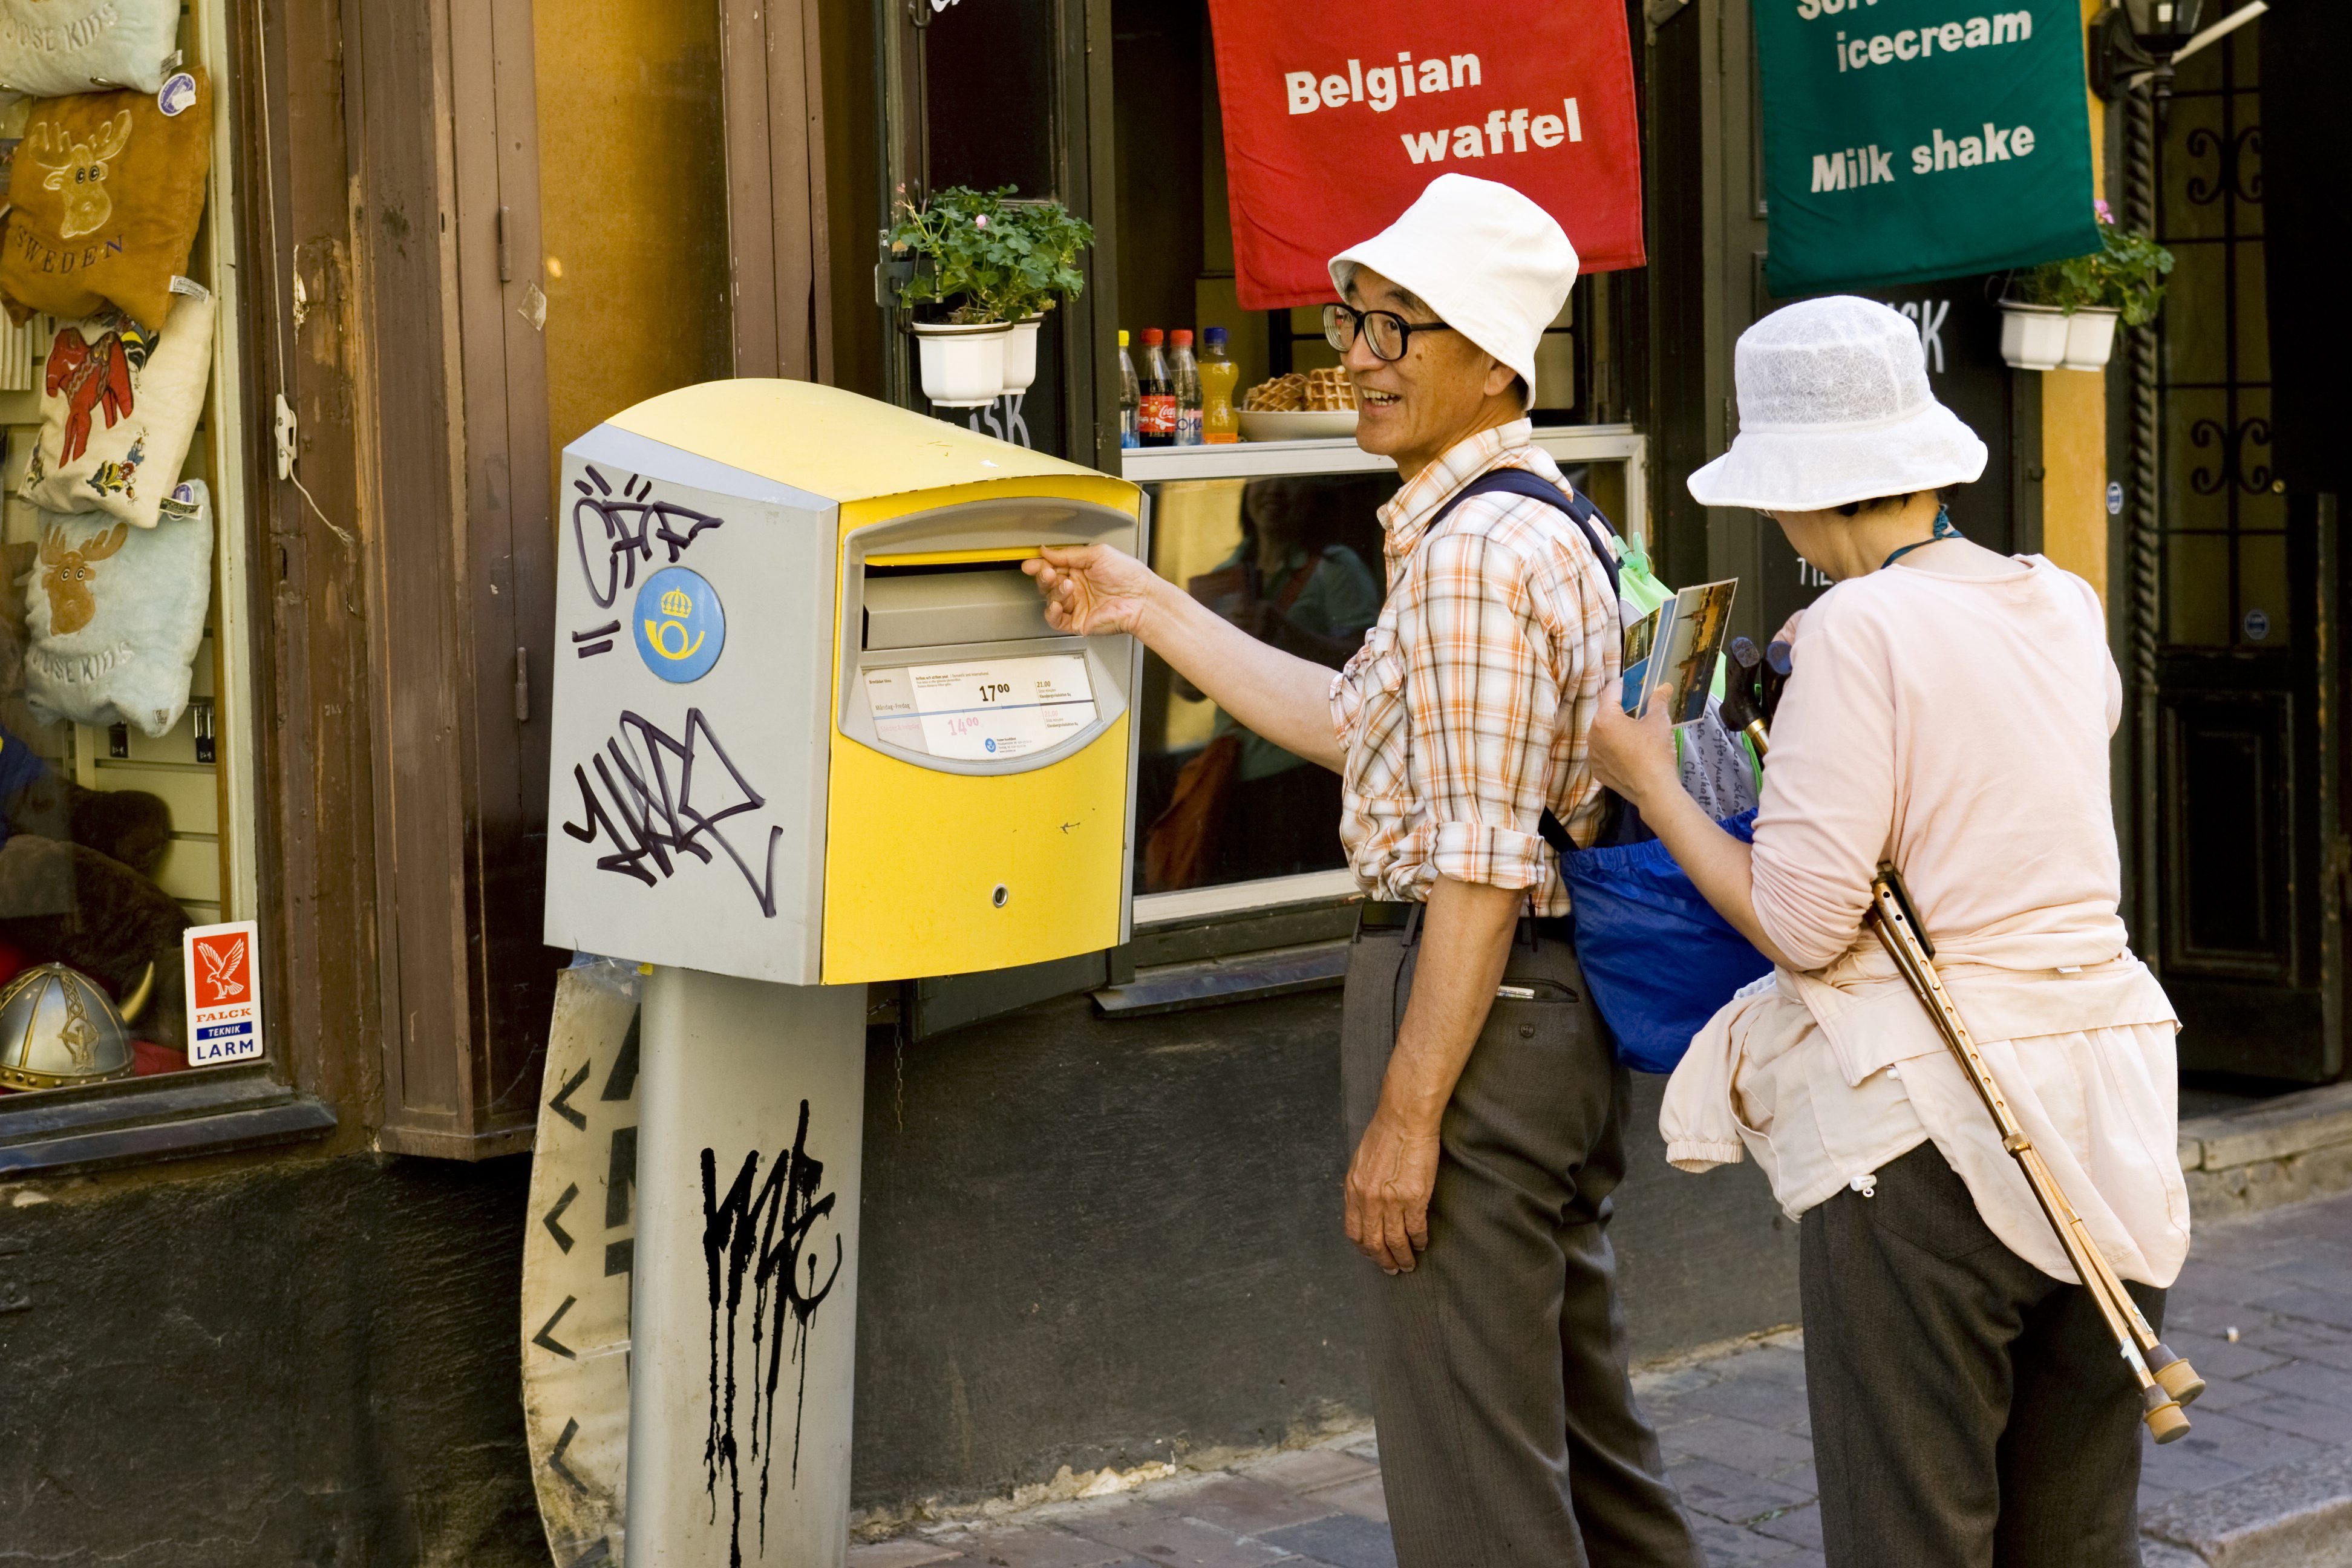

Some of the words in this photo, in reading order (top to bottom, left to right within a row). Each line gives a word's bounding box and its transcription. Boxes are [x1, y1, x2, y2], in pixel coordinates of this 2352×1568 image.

[62, 2, 119, 52] KIDS
[1837, 10, 2032, 72] icecream
[1284, 51, 1481, 115] Belgian
[1400, 97, 1582, 165] waffel
[1811, 144, 1895, 193] Milk
[1912, 123, 2035, 175] shake
[16, 225, 125, 275] SWEDEN
[196, 1008, 252, 1022] FALCK
[209, 1025, 241, 1037] TEKNIK
[197, 1039, 253, 1060] LARM
